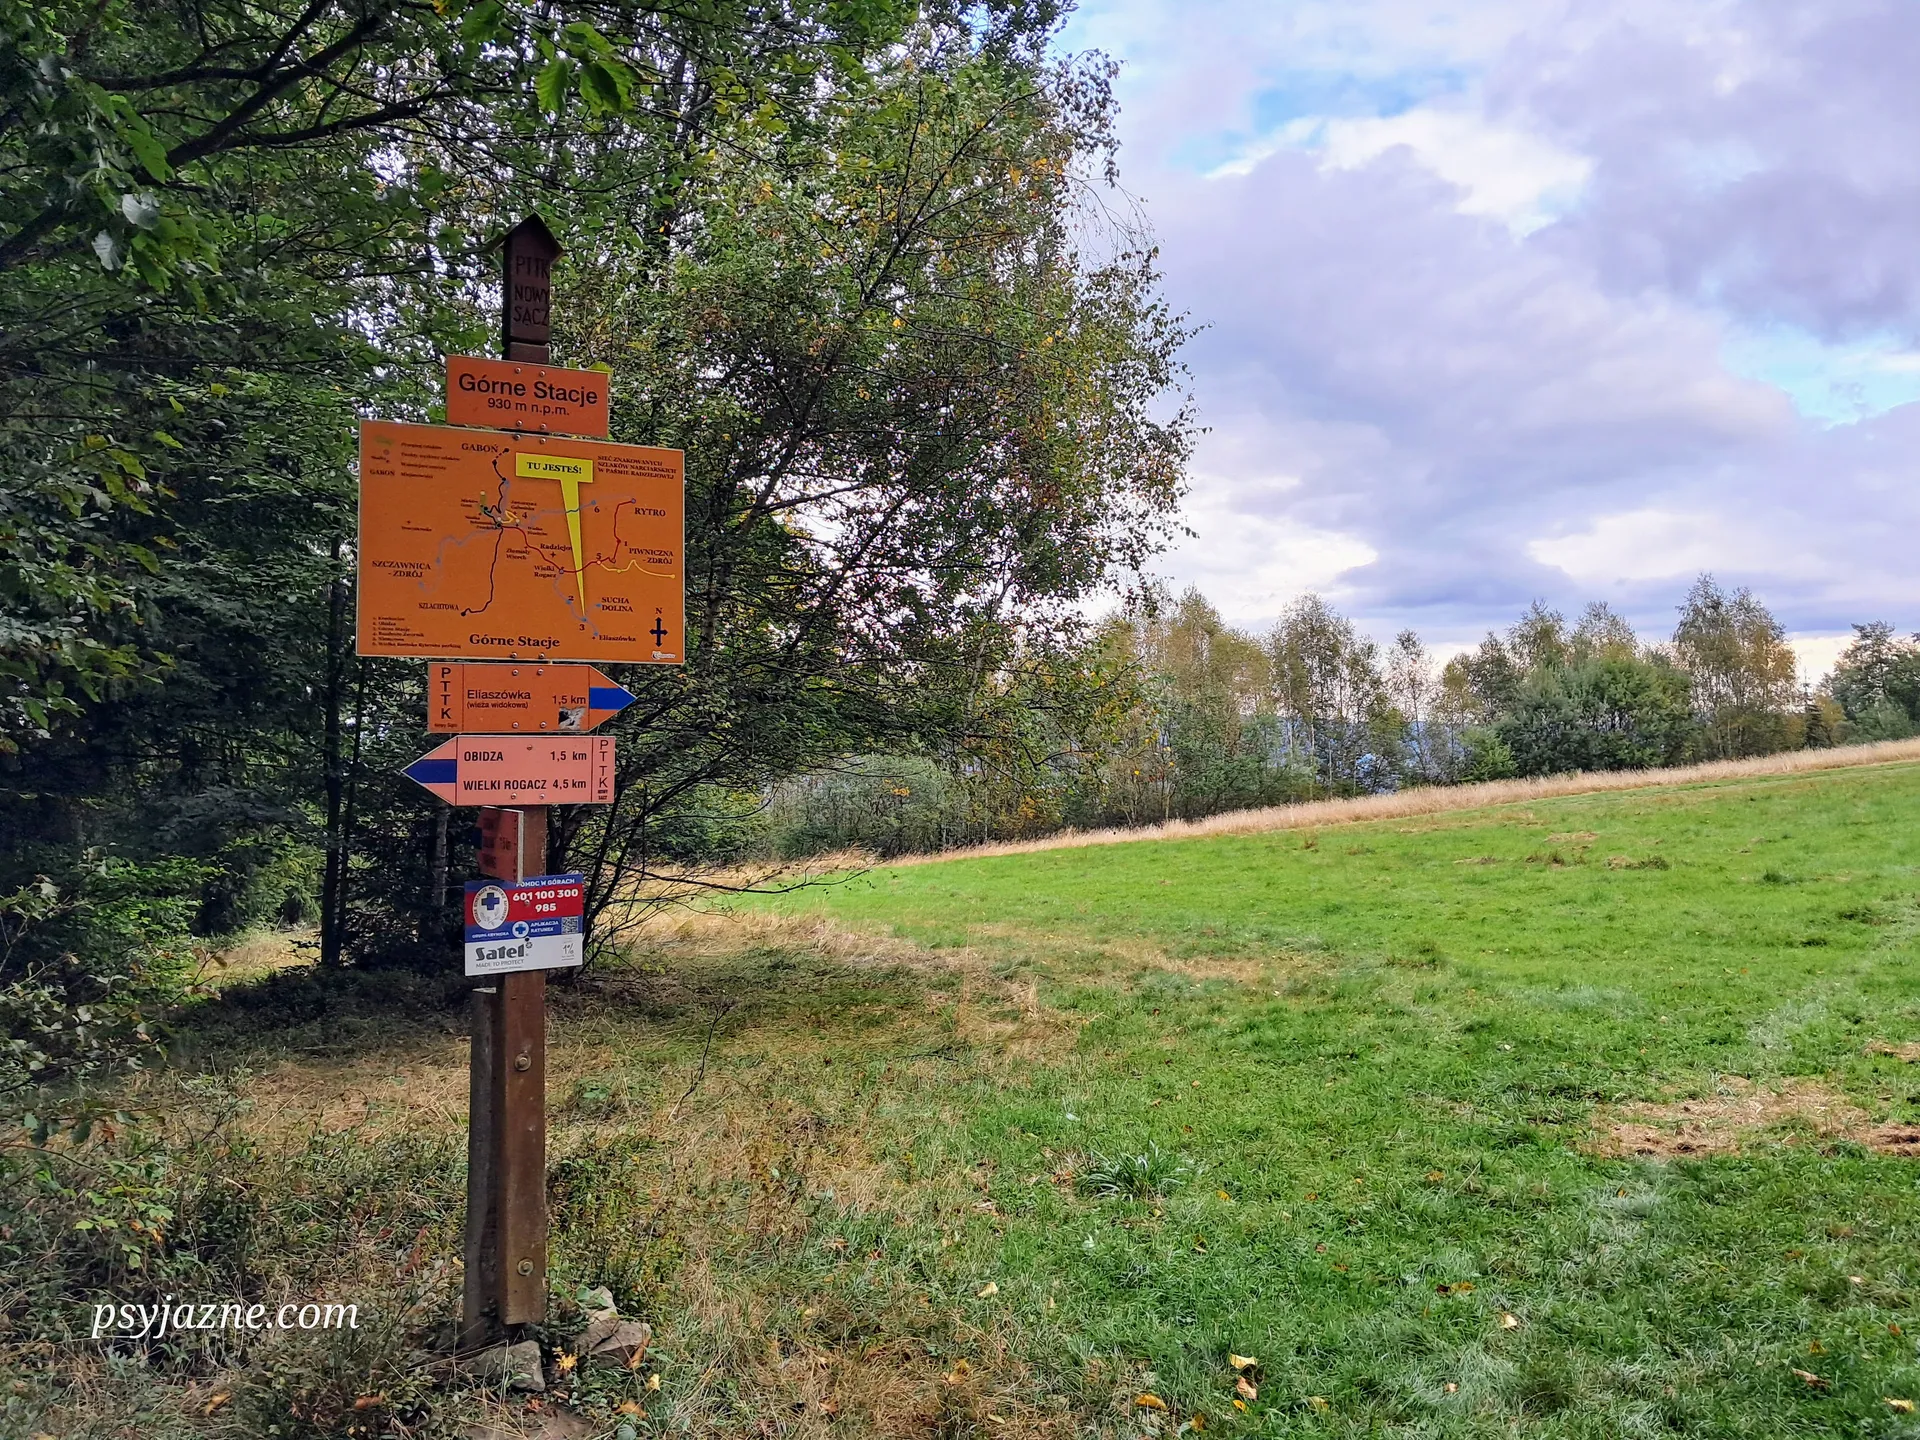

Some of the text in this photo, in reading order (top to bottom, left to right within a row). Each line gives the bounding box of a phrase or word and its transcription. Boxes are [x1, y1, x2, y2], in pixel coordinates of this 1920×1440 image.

[516, 255, 550, 279] PTTK
[515, 284, 550, 304] NOWY
[513, 305, 549, 326] SĄCZ
[459, 373, 598, 408] Górne Stacje
[488, 397, 570, 415] 930 m n.p.m.
[526, 462, 582, 474] TU JESTEŚ!
[522, 511, 528, 520] 4
[594, 506, 600, 514] 6
[634, 507, 667, 517] RYTRO
[596, 552, 602, 560] 5
[628, 547, 674, 557] PIWNICZNA
[372, 560, 432, 570] SZCZAWNICA
[393, 570, 423, 578] ZDRÓJ
[601, 604, 634, 613] DOLINA
[655, 607, 663, 615] N
[469, 633, 515, 646] Górne
[517, 636, 561, 650] Stacje
[467, 689, 587, 706] Eliaszówka 1,5 km
[464, 750, 587, 762] OBIDZA 1,5 km
[463, 778, 587, 791] WIELKI ROGACZ 4,5 km
[547, 878, 575, 886] GÓRACH
[513, 888, 579, 902] 601 100 300
[535, 902, 557, 913] 985
[475, 944, 525, 962] Satel
